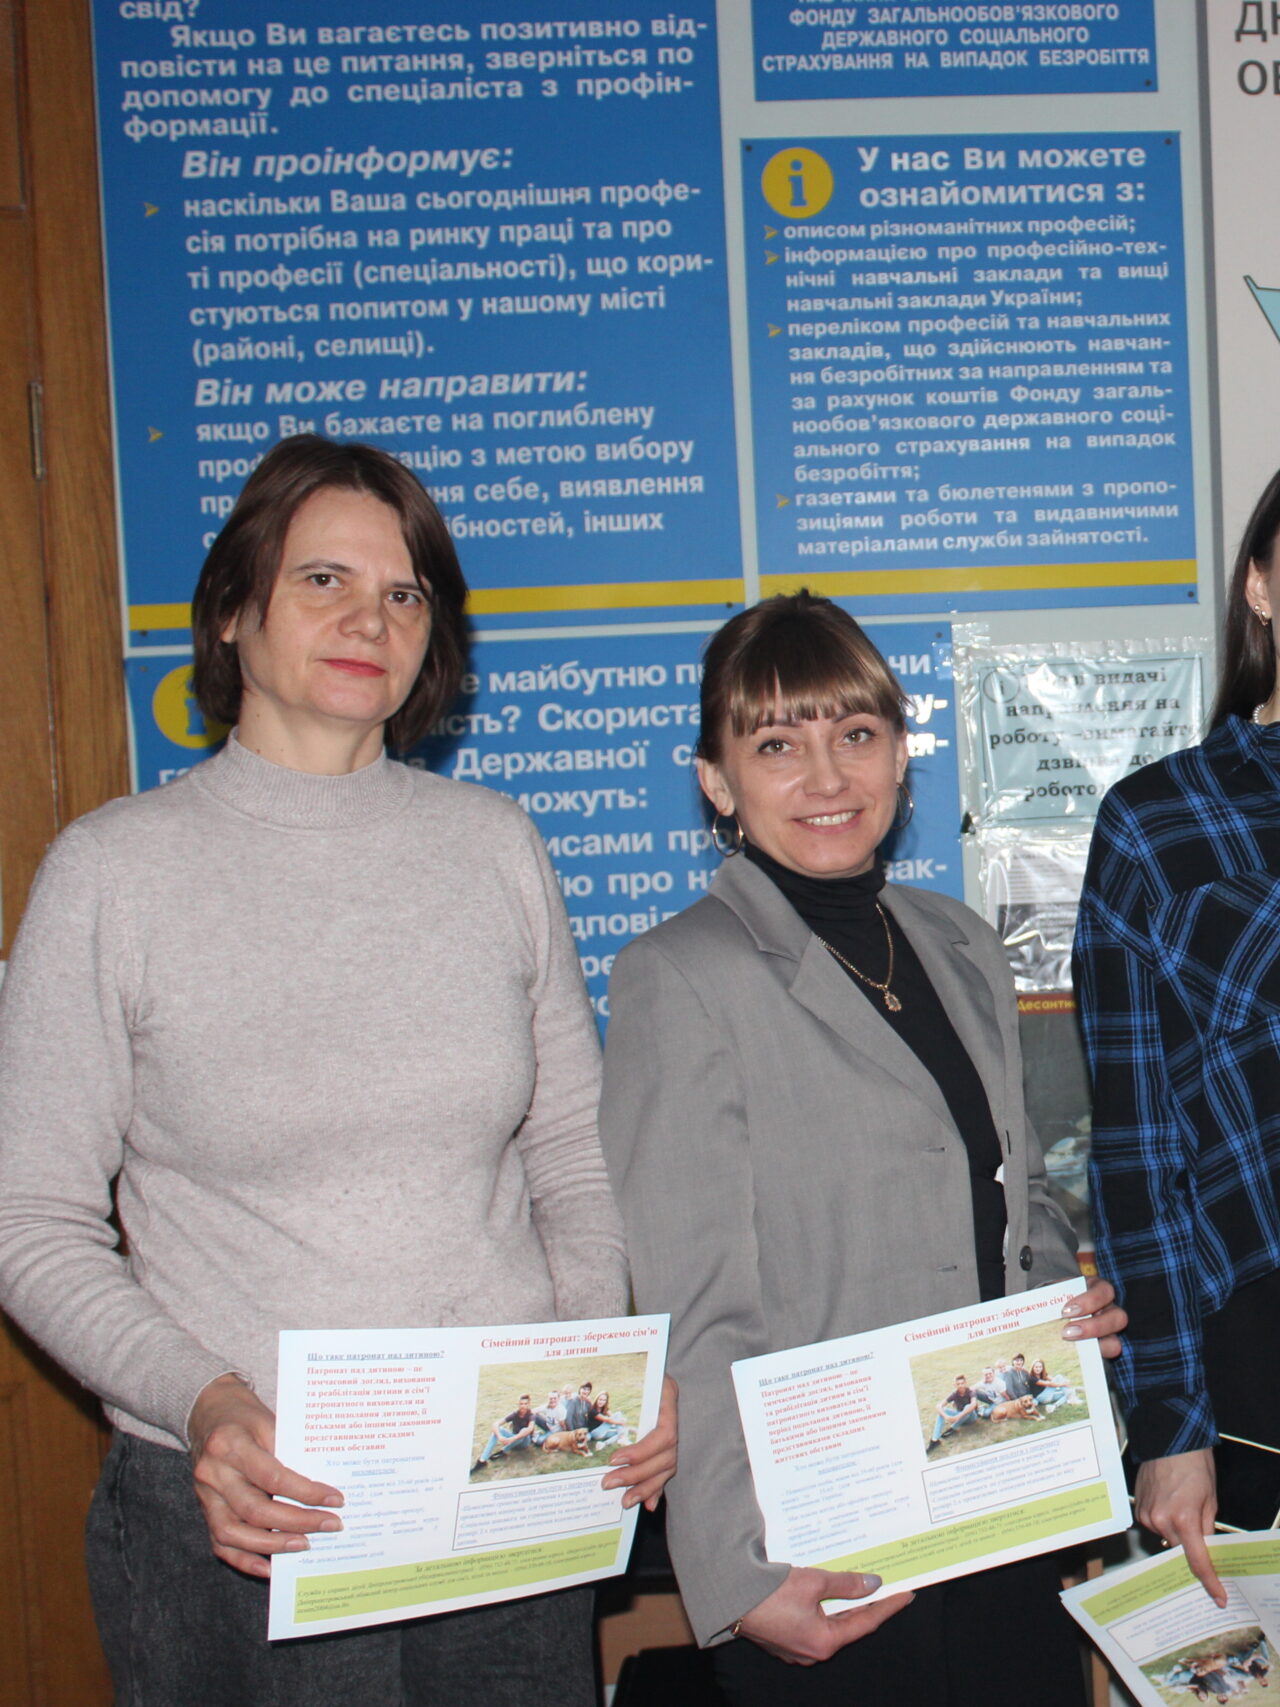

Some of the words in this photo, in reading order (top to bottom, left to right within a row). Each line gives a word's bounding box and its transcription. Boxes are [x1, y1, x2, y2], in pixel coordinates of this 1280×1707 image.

[119, 0, 199, 21] свід?
[789, 8, 856, 27] ФОНДУ
[170, 25, 255, 49] Якщо
[266, 23, 306, 45] Ви
[318, 24, 470, 44] вагаєтесь
[481, 20, 640, 40] позитивно
[651, 14, 707, 38] від-
[821, 29, 948, 49] ДЕРЖАВНОГО
[960, 26, 1089, 46] СОЦІАЛЬНОГО
[121, 54, 236, 78] повісти
[247, 58, 282, 75] на
[294, 56, 330, 77] це
[341, 53, 474, 74] питання,
[485, 45, 647, 72] зверніться
[658, 47, 693, 64] по
[762, 53, 893, 72] СТРАХУВАННЯ
[905, 52, 929, 68] НА
[940, 50, 1028, 69] ВИПАДОК
[1039, 48, 1148, 65] БЕЗРОБІТТЯ
[122, 88, 271, 111] допомогу
[289, 86, 328, 107] до
[347, 76, 523, 103] спеціаліста
[542, 79, 558, 96] з
[577, 71, 693, 99] профін-
[123, 113, 278, 141] формації.
[182, 150, 240, 178] Він
[253, 146, 512, 180] проінформує:
[858, 147, 879, 172] У
[891, 151, 950, 171] нас
[964, 148, 1006, 170] Ви
[1018, 147, 1146, 168] можете
[184, 192, 320, 216] наскільки
[330, 189, 406, 212] Ваша
[416, 183, 591, 210] сьогоднішня
[601, 179, 700, 208] профе-
[860, 180, 1104, 207] ознайомитися
[1116, 182, 1144, 201] з:
[186, 230, 225, 253] сія
[235, 224, 357, 255] потрібна
[368, 229, 399, 247] на
[410, 226, 490, 250] ринку
[499, 217, 573, 247] праці
[582, 222, 612, 239] та
[622, 219, 672, 242] про
[784, 218, 865, 238] описом
[870, 218, 1023, 240] різноманітних
[1028, 215, 1135, 235] професій;
[785, 244, 927, 266] інформацією
[938, 246, 977, 262] про
[987, 240, 1166, 260] професійно-тех-
[187, 266, 209, 288] ті
[219, 261, 343, 293] професії
[354, 253, 576, 288] (спеціальності),
[587, 256, 628, 278] що
[638, 254, 712, 277] кори-
[189, 304, 319, 330] стуються
[329, 299, 448, 320] попитом
[457, 298, 472, 320] у
[482, 294, 591, 316] нашому
[601, 285, 665, 309] місті
[787, 292, 893, 311] навчальні
[897, 294, 986, 309] заклади
[990, 288, 1082, 308] України;
[788, 318, 900, 339] переліком
[908, 314, 1009, 336] професій
[1016, 317, 1040, 328] та
[1047, 314, 1170, 328] навчальних
[192, 335, 304, 366] (районі,
[315, 330, 433, 358] селищі).
[195, 378, 253, 406] Він
[265, 379, 366, 403] може
[379, 371, 587, 401] направити:
[196, 422, 269, 443] якщо
[279, 415, 315, 438] Ви
[325, 412, 442, 436] бажаєте
[452, 413, 483, 430] на
[493, 402, 654, 429] поглиблену
[983, 411, 1113, 429] державного
[1121, 404, 1173, 423] соці-
[471, 449, 486, 467] з
[496, 445, 586, 466] метою
[596, 435, 694, 463] вибору
[794, 443, 880, 457] ального
[896, 438, 1030, 456] страхування
[1046, 436, 1071, 448] на
[1087, 433, 1175, 448] випадок
[795, 462, 919, 483] безробіття;
[474, 476, 549, 503] себе,
[559, 474, 704, 499] виявлення
[796, 491, 896, 506] газетами
[906, 489, 928, 501] та
[939, 484, 1073, 500] бюлетенями
[1083, 484, 1093, 496] з
[1104, 481, 1176, 498] пропо-
[583, 511, 664, 533] інших
[797, 513, 883, 531] зиціями
[901, 509, 977, 530] роботи
[994, 511, 1017, 522] та
[1035, 505, 1178, 523] видавничими
[798, 536, 937, 556] матеріалами
[943, 530, 1022, 551] служби
[1027, 527, 1148, 546] зайнятості.
[489, 661, 666, 696] майбутню
[453, 740, 649, 780] Державної
[607, 871, 673, 900] про
